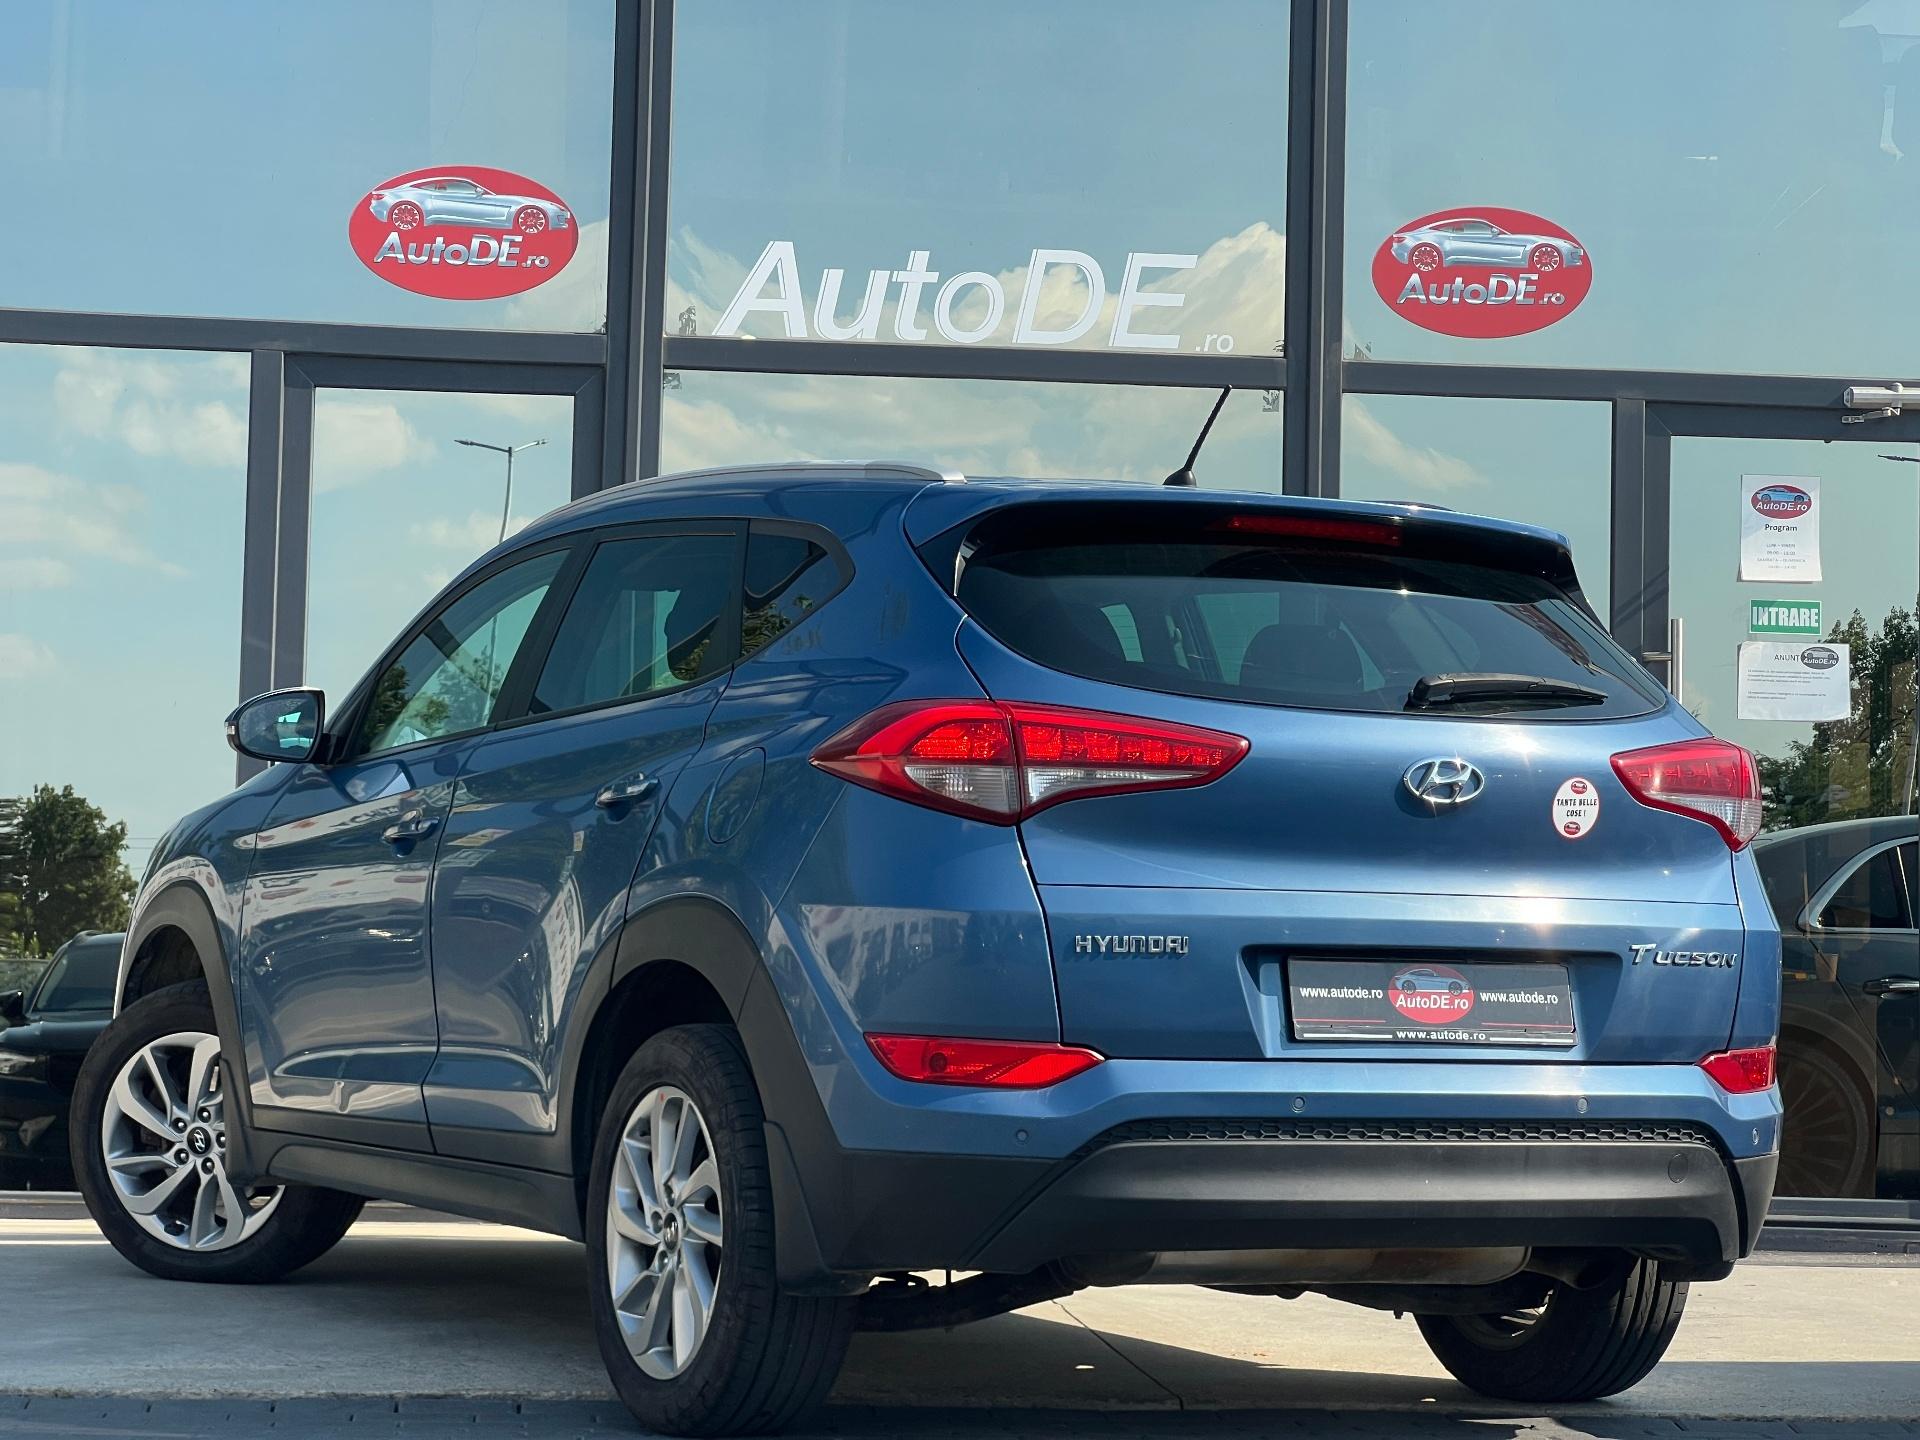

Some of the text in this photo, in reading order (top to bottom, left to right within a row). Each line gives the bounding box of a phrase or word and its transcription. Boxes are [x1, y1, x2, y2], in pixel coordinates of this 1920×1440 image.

[1755, 501, 1808, 511] AutoDE.ro
[1764, 523, 1798, 532] Program
[1752, 606, 1819, 627] INTRARE
[1556, 798, 1598, 806] TANTE BELLE
[1566, 809, 1582, 817] COSE
[1075, 935, 1189, 954] HYUNDAI
[1299, 986, 1384, 999] www.autode.ro
[1479, 990, 1559, 1004] www.autode.ro
[1395, 994, 1470, 1011] AutoDE.ro
[1396, 1030, 1486, 1041] www.autode.ro
